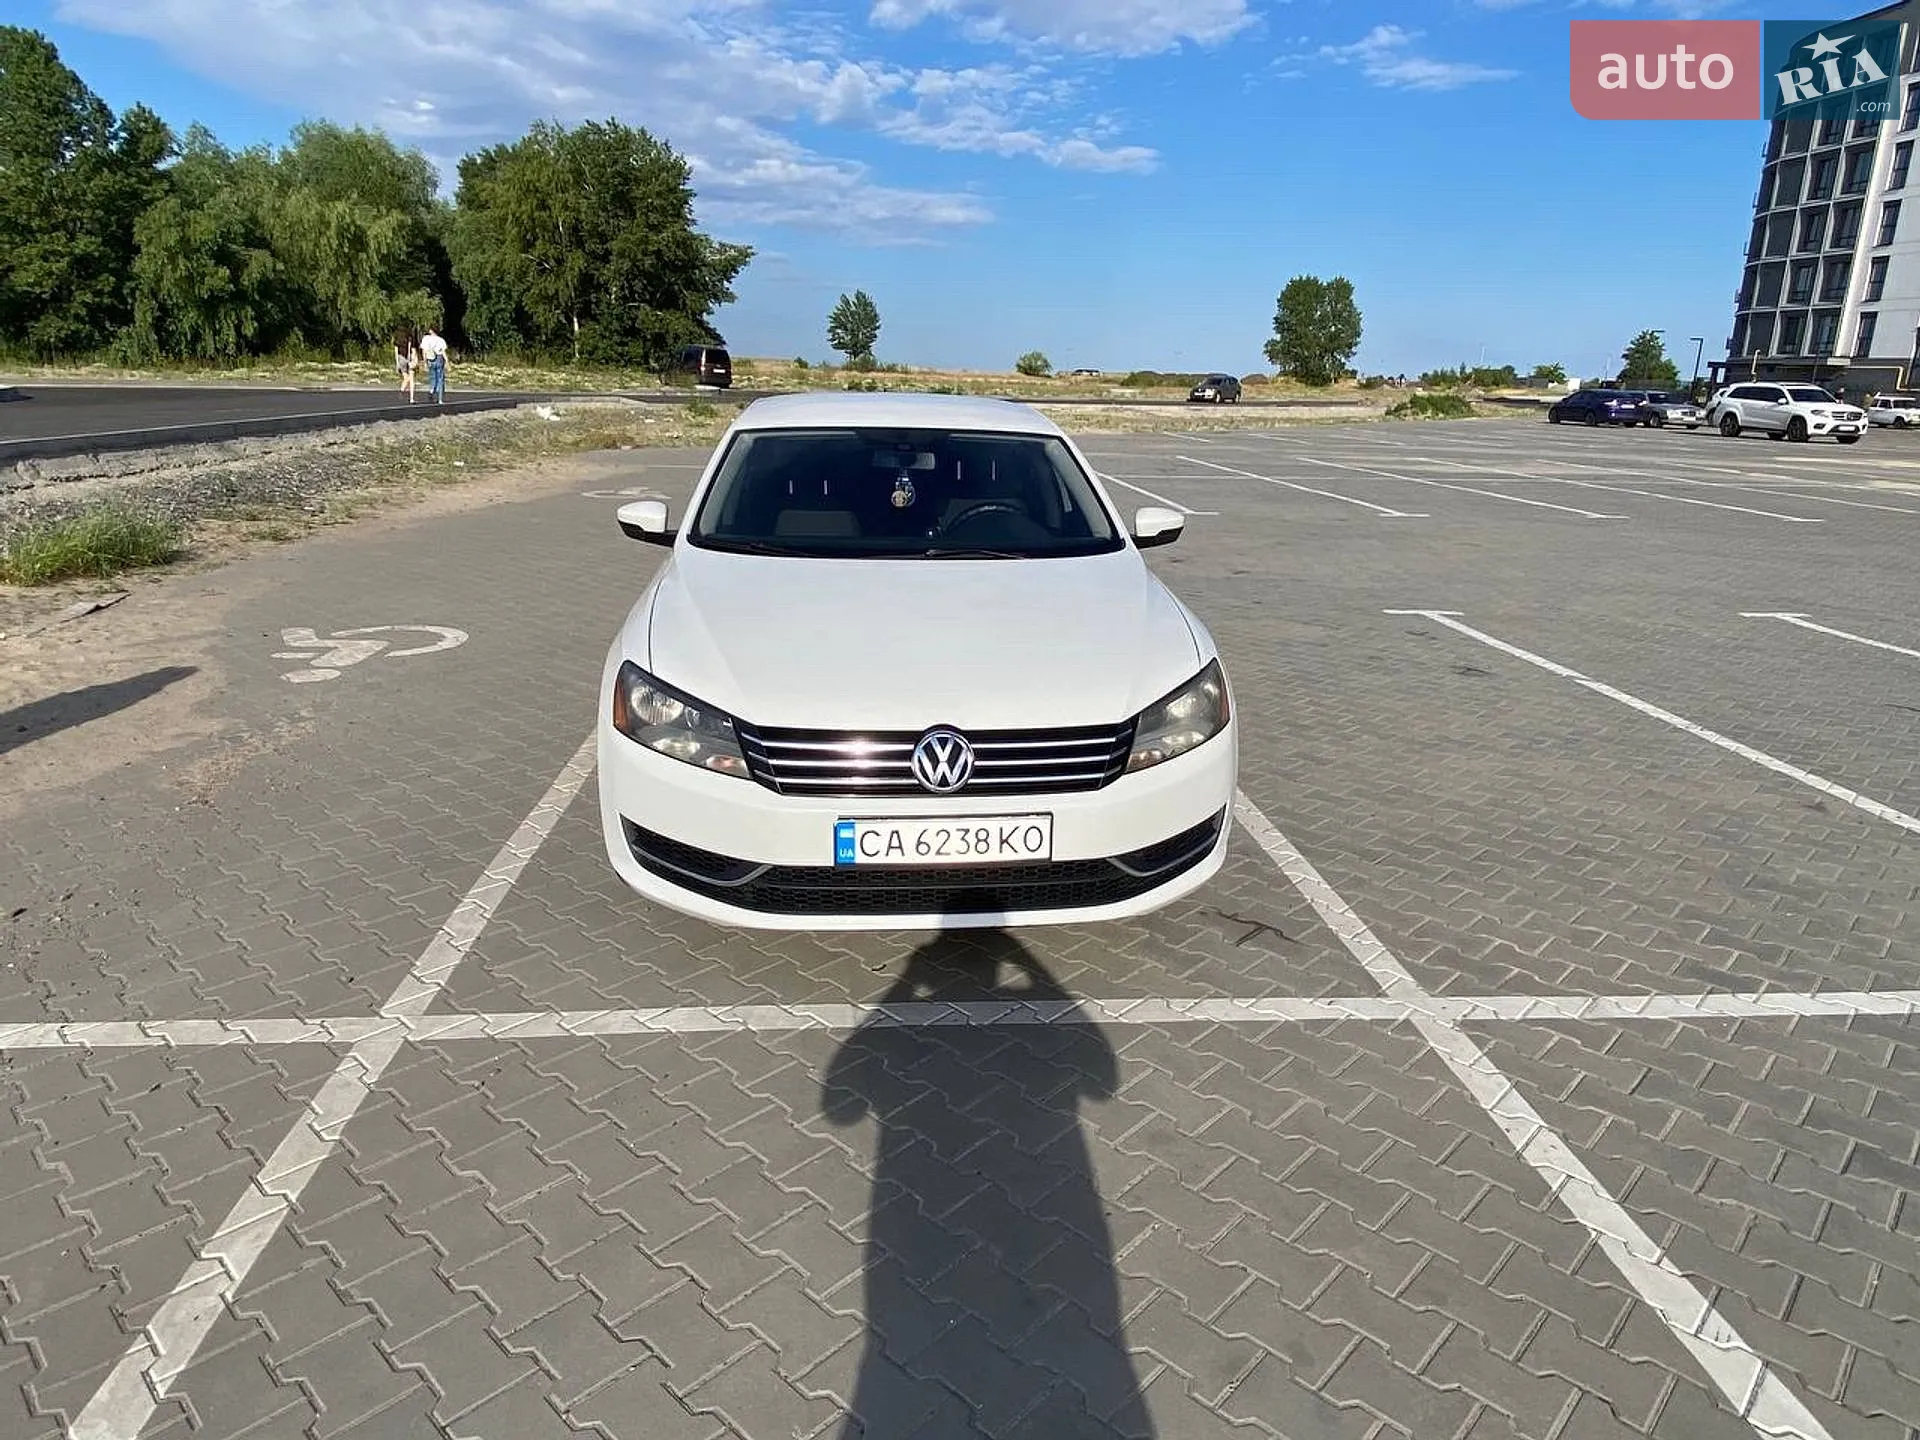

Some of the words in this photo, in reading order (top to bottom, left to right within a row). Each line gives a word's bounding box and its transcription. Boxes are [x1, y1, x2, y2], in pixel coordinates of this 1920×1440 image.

[913, 731, 973, 792] VW
[860, 829, 905, 857] CA
[915, 828, 990, 856] 6238
[999, 826, 1044, 854] KO
